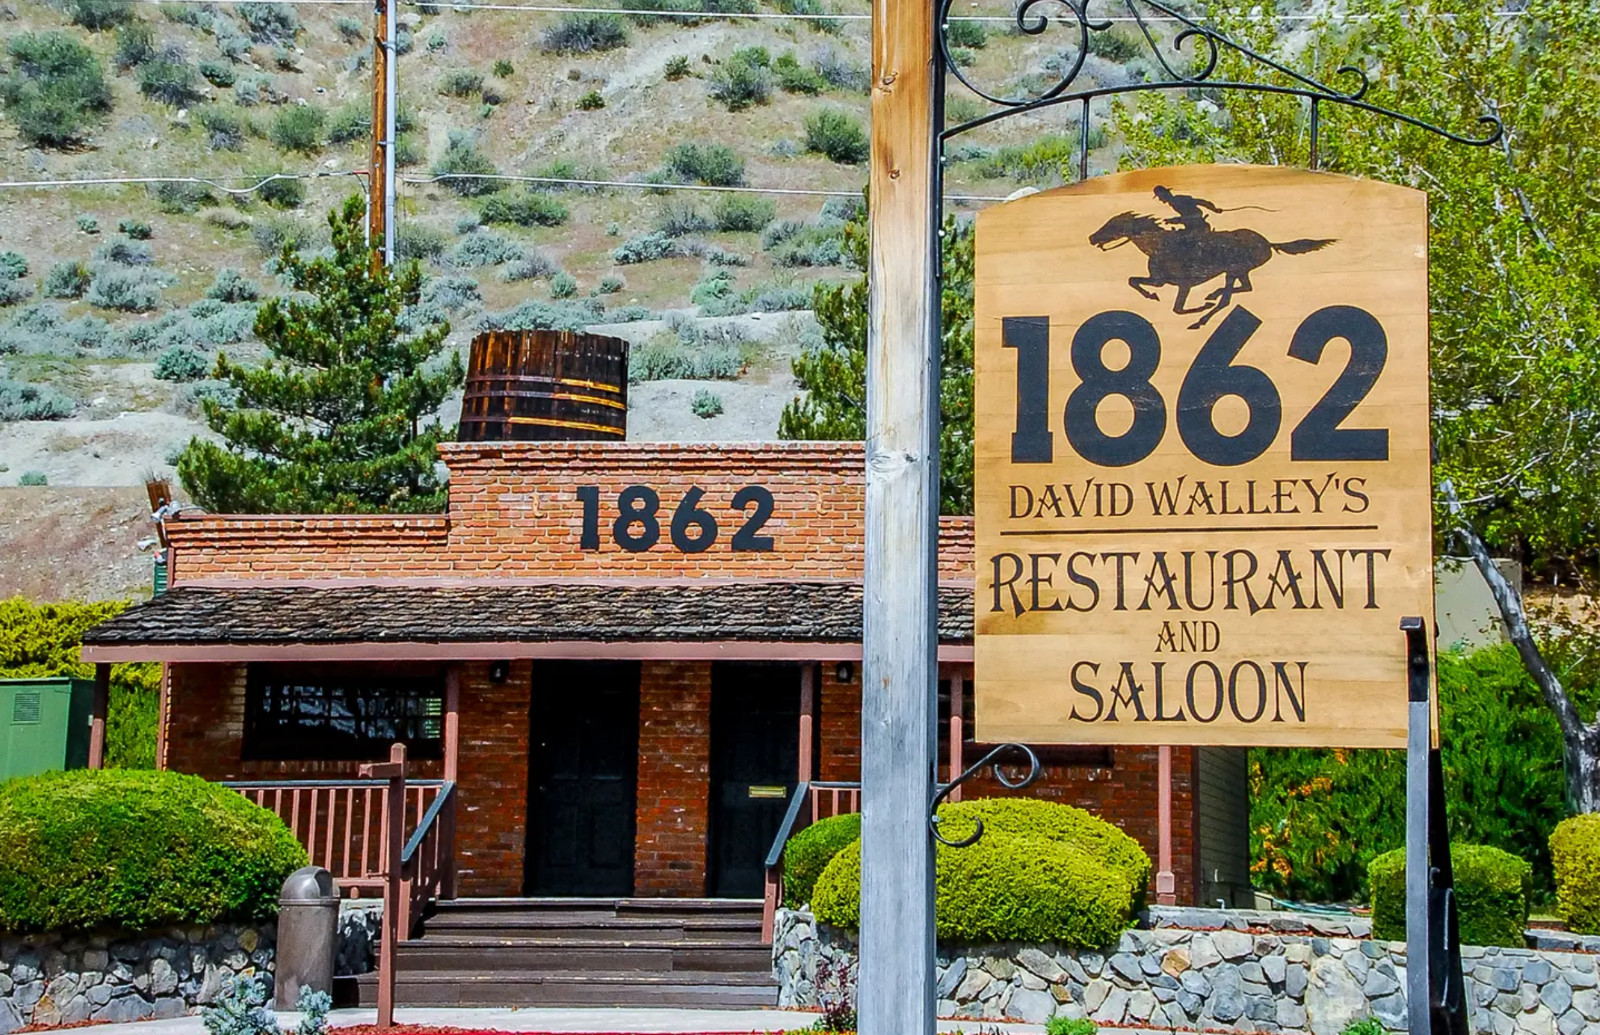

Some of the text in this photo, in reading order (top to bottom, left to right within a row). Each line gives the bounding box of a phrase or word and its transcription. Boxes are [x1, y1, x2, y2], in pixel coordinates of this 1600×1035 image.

[1001, 304, 1390, 467] 1862
[576, 484, 775, 554] 1862
[1009, 473, 1370, 519] DAVID WALLEY'S
[989, 549, 1391, 620] RESTAURANT
[1154, 620, 1221, 653] AND
[1068, 660, 1308, 723] SALOON
